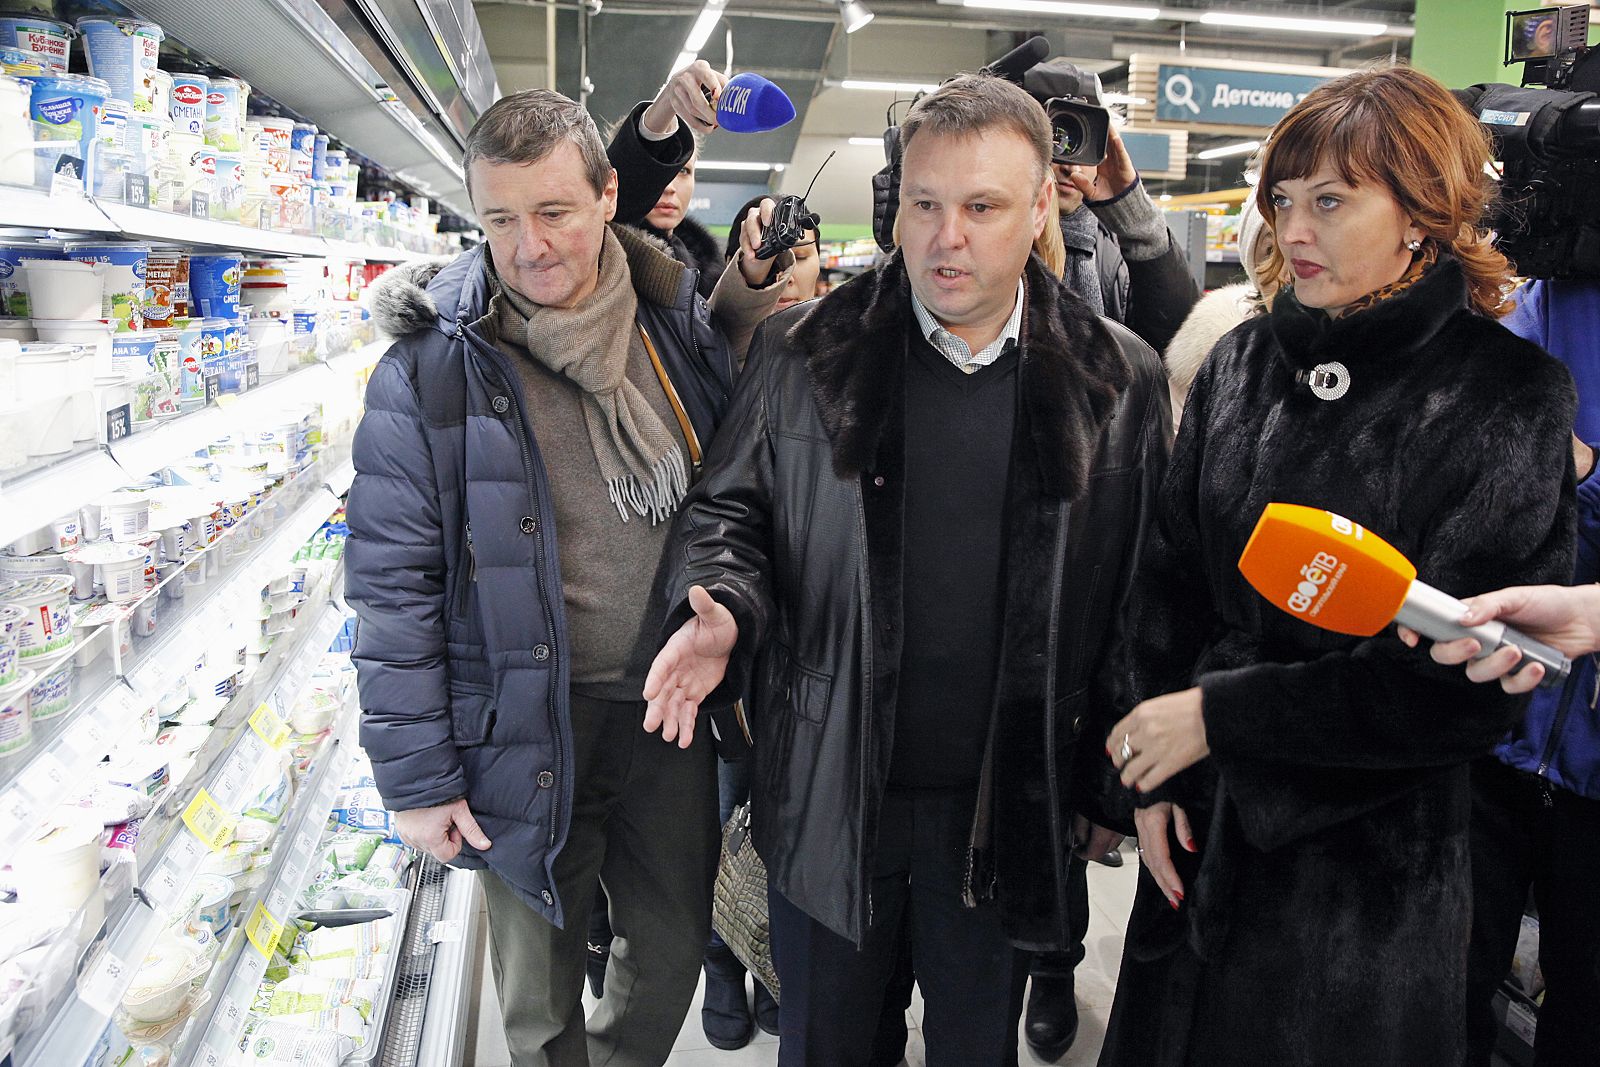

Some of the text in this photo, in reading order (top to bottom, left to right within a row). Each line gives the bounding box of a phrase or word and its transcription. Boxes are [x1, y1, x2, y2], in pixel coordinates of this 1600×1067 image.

[718, 85, 752, 115] ОССИЯ
[1212, 83, 1294, 109] Детские
[131, 185, 145, 204] 15%
[111, 417, 126, 440] 15%
[107, 963, 121, 978] 33
